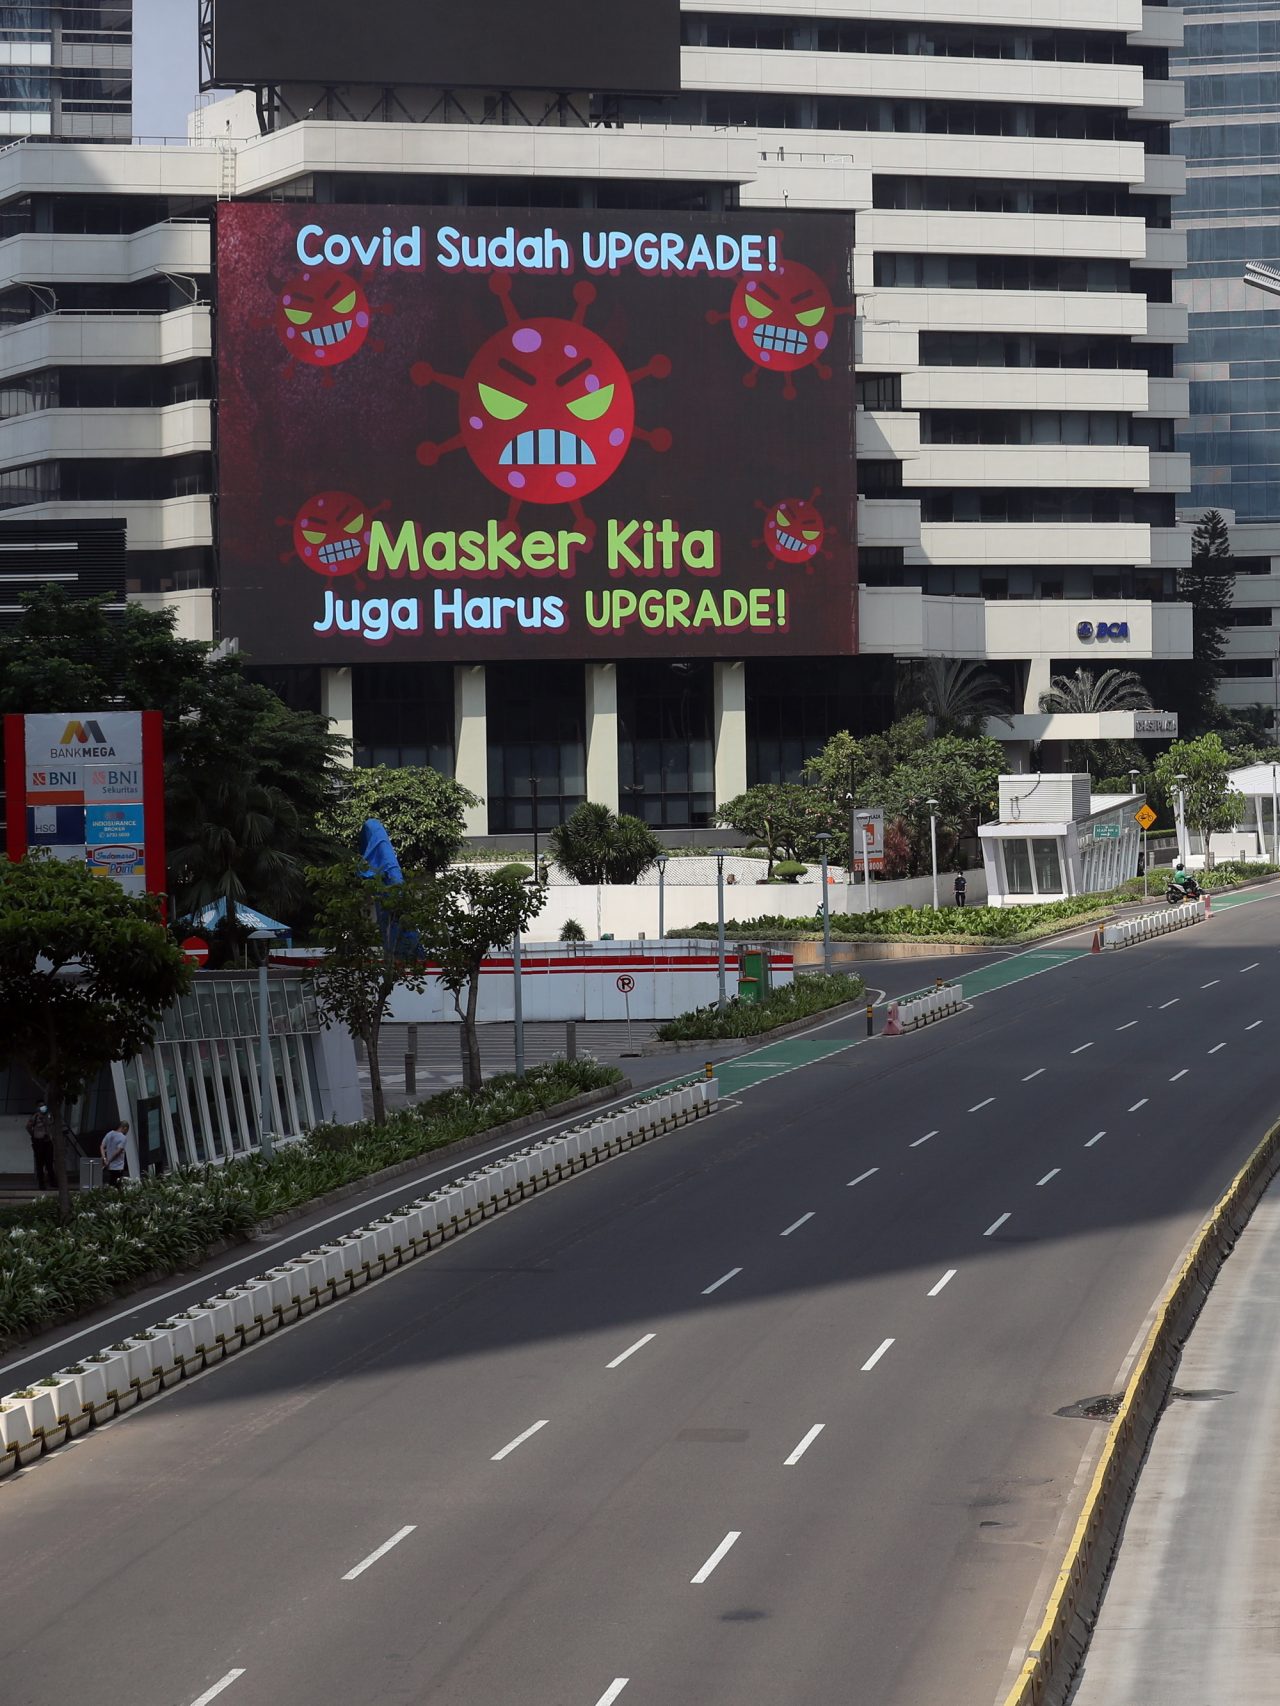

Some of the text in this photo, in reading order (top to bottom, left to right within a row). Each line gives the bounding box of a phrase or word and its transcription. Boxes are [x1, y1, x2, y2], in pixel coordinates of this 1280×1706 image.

[297, 225, 778, 272] Covid Sudah UPGRADE!
[366, 518, 715, 572] Masker Kita
[313, 588, 787, 641] Juga Harus UPGRADE!
[1096, 622, 1128, 638] BCA
[49, 771, 77, 785] BNI
[108, 770, 138, 785] BNI
[102, 786, 138, 794] Sekuritas
[95, 851, 135, 860] Indomaret
[109, 863, 135, 875] Point
